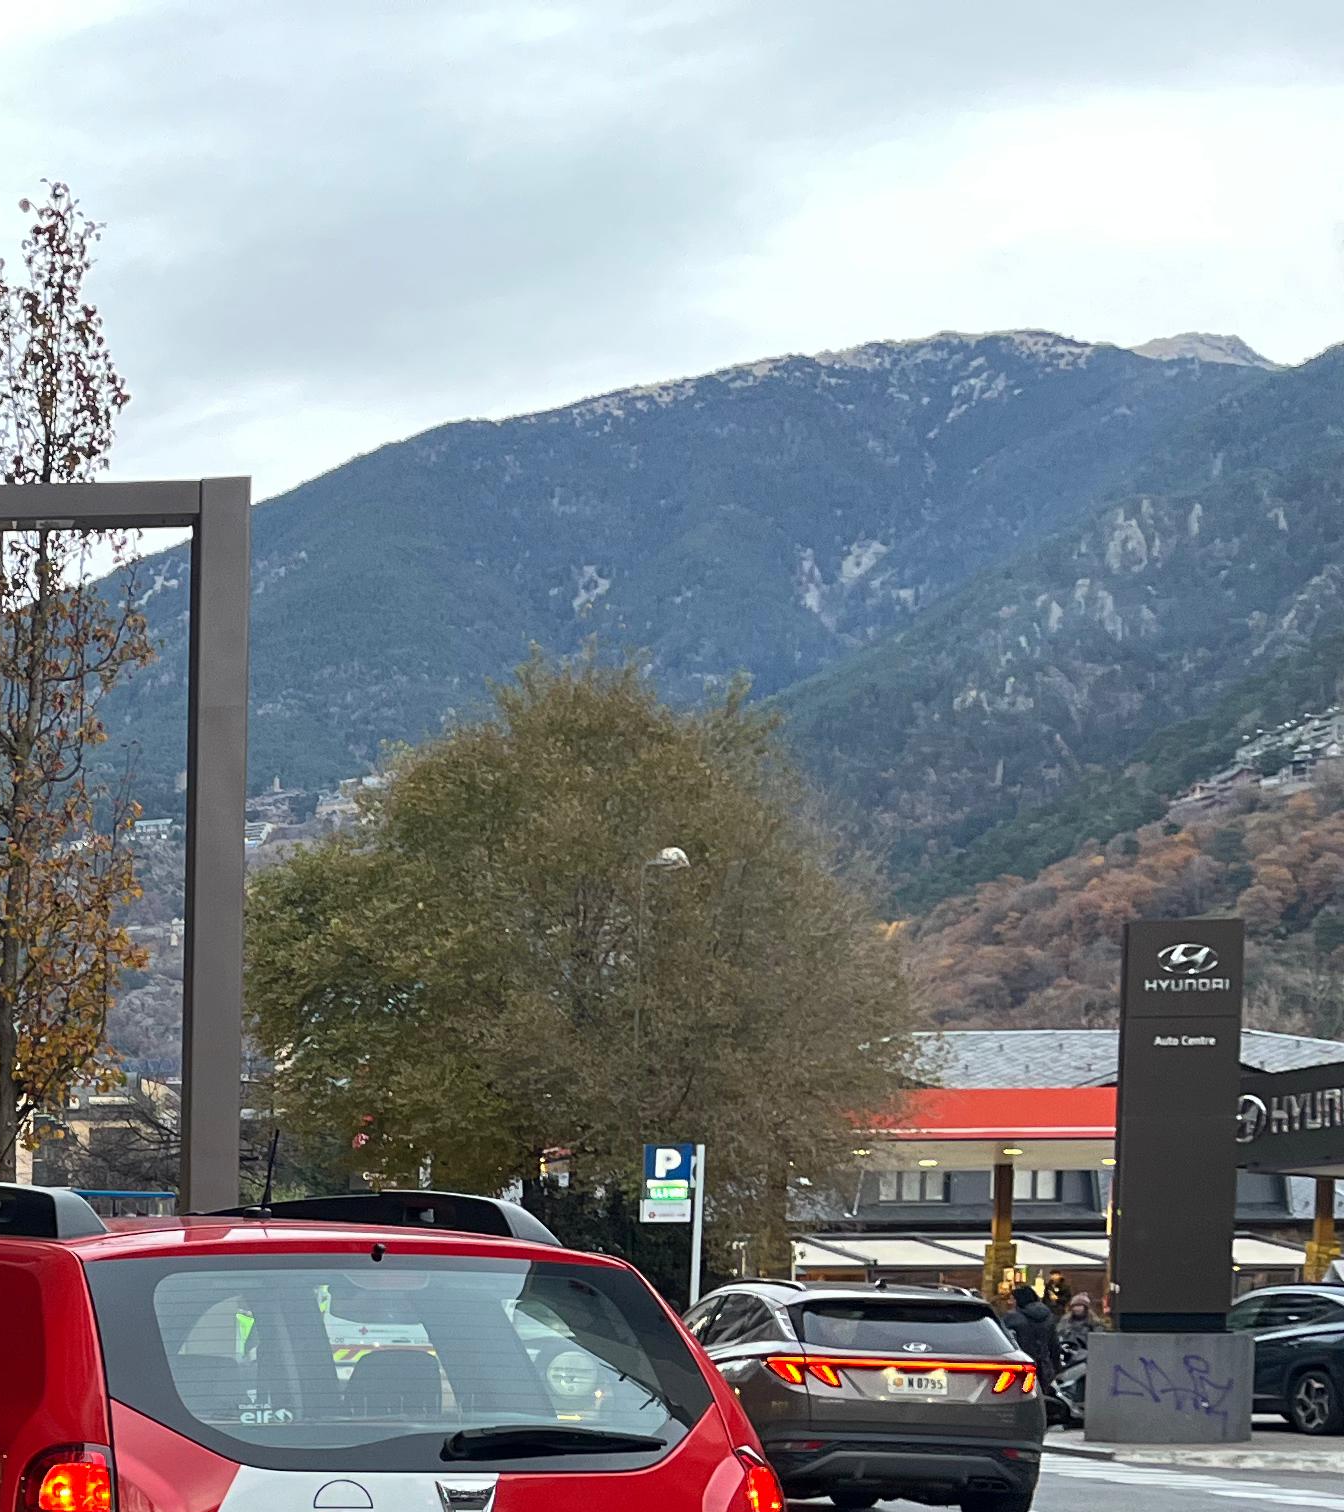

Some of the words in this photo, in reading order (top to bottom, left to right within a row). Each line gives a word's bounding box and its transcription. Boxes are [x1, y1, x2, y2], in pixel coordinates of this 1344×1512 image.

[1144, 979, 1230, 991] HYUNDAI
[1153, 1036, 1179, 1046] Auto
[1181, 1035, 1216, 1046] Centre
[1271, 1088, 1344, 1134] HYUN
[655, 1148, 682, 1178] P
[240, 1410, 273, 1424] elf
